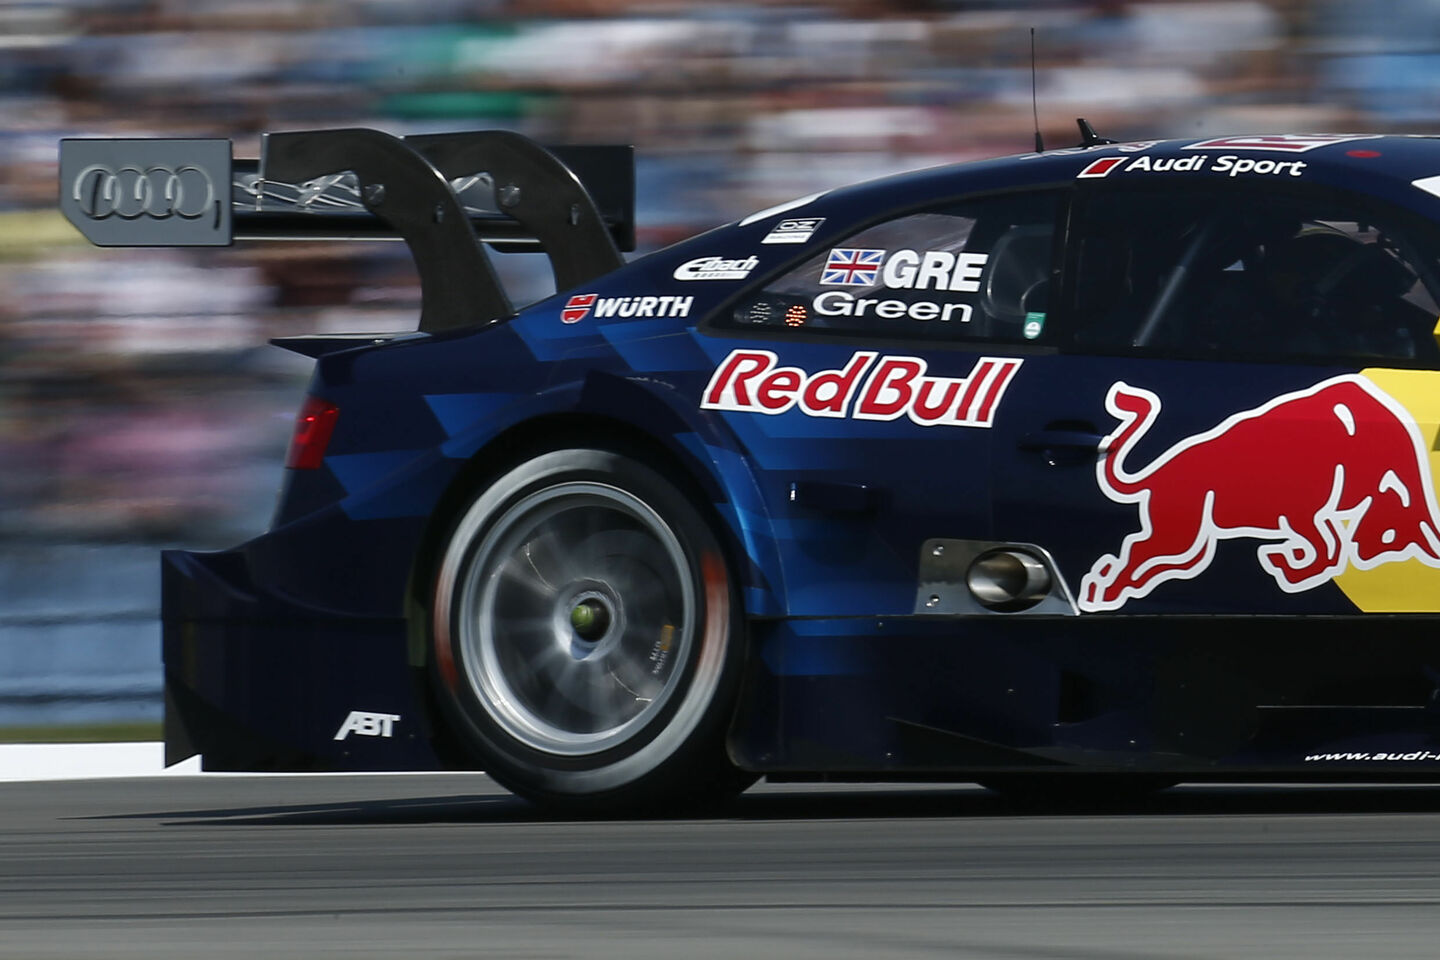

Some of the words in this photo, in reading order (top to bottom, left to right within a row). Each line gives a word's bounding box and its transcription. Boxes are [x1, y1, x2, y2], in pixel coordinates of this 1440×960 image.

[1125, 155, 1208, 172] Audi
[1211, 155, 1307, 177] Sport
[882, 249, 989, 293] GRE
[812, 291, 974, 323] Green
[333, 710, 401, 740] ABT
